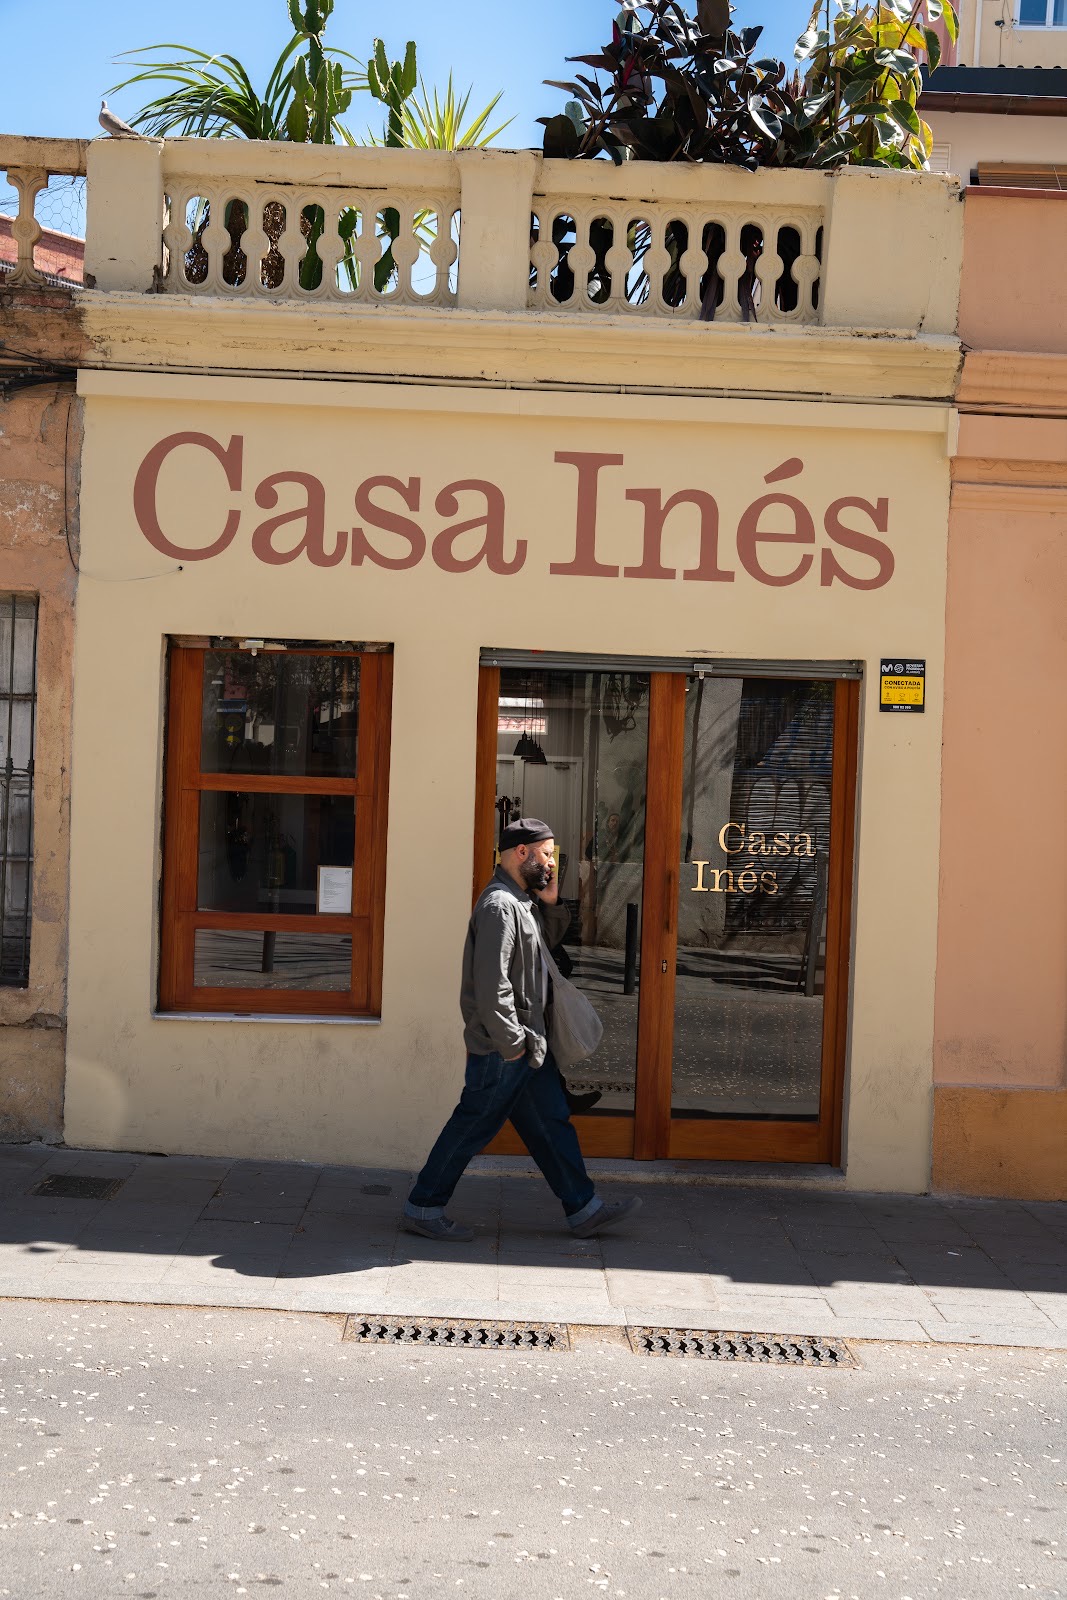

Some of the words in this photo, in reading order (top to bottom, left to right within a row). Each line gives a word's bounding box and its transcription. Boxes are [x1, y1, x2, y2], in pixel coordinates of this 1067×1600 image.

[134, 431, 528, 574] Casa
[549, 451, 895, 590] Inés
[718, 822, 817, 857] Casa
[690, 860, 779, 895] Inés
